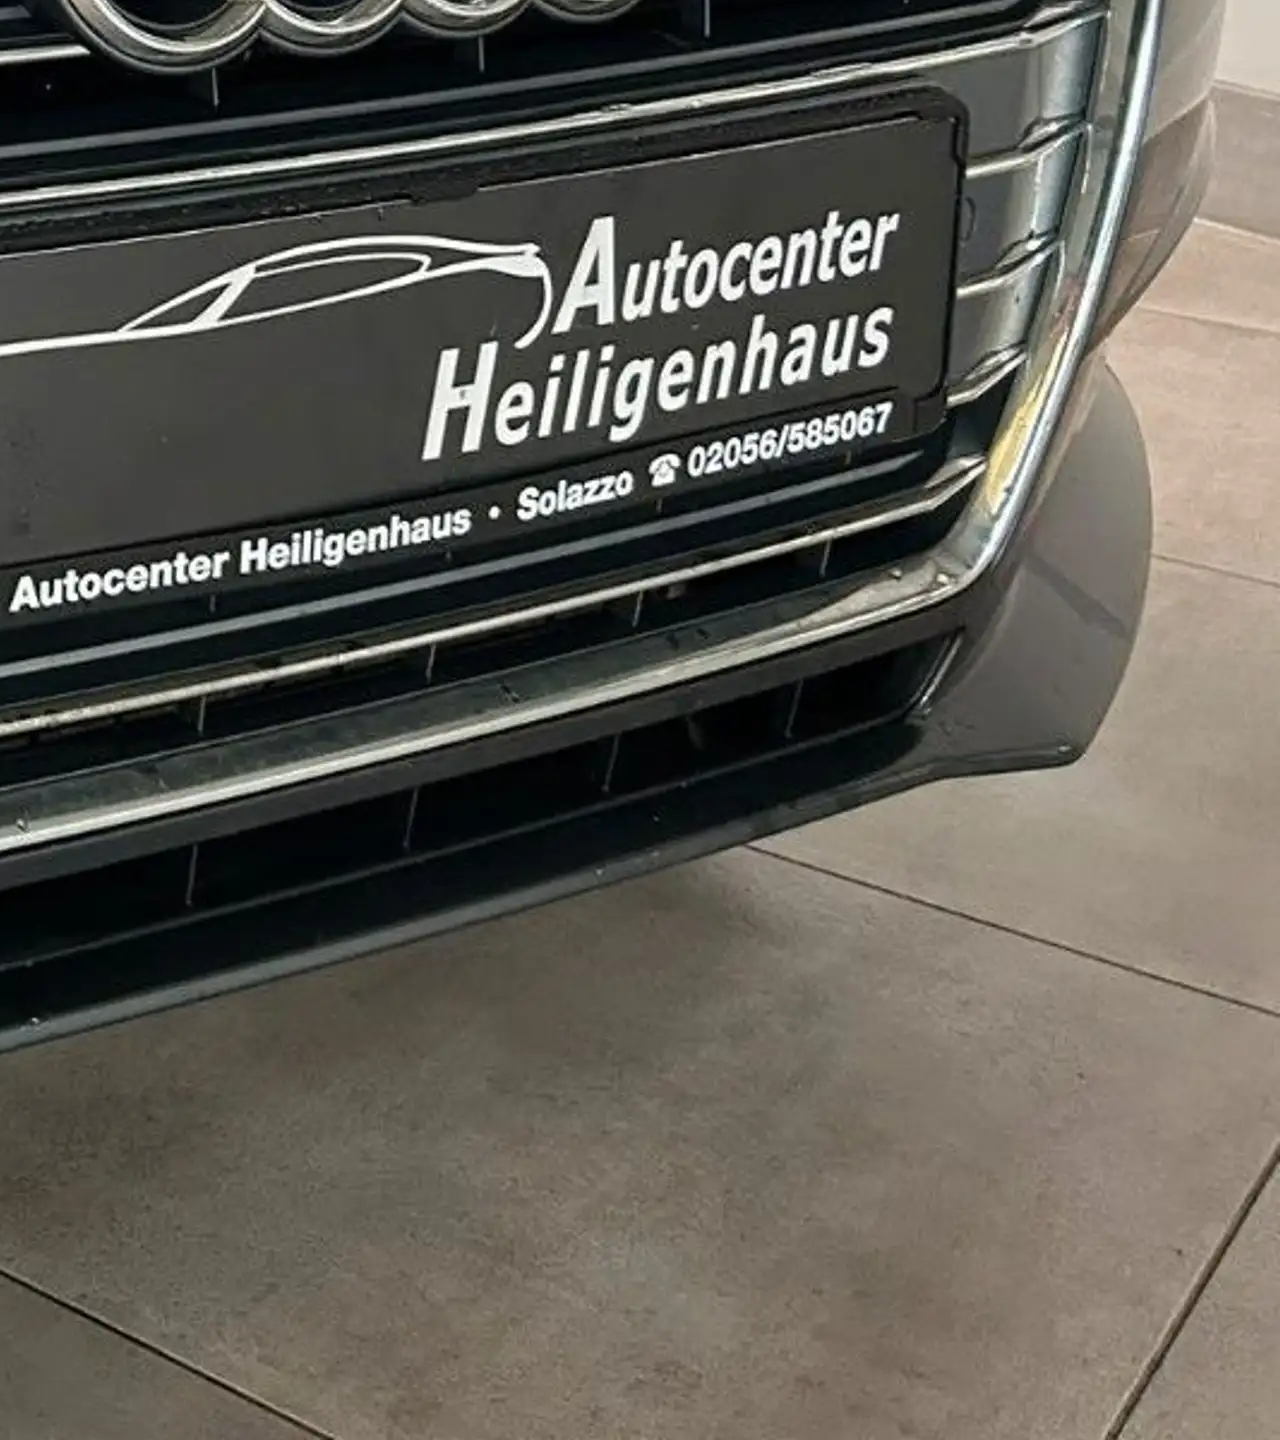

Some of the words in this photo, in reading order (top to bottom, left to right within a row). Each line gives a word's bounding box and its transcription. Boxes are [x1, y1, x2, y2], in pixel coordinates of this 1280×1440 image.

[551, 210, 900, 335] Autocenter
[422, 307, 894, 460] Heiligenhaus
[9, 546, 229, 612] Autocenter
[240, 507, 472, 574] Heiligenhaus
[517, 470, 633, 520] Solazzo
[687, 401, 893, 478] 02056/585067
